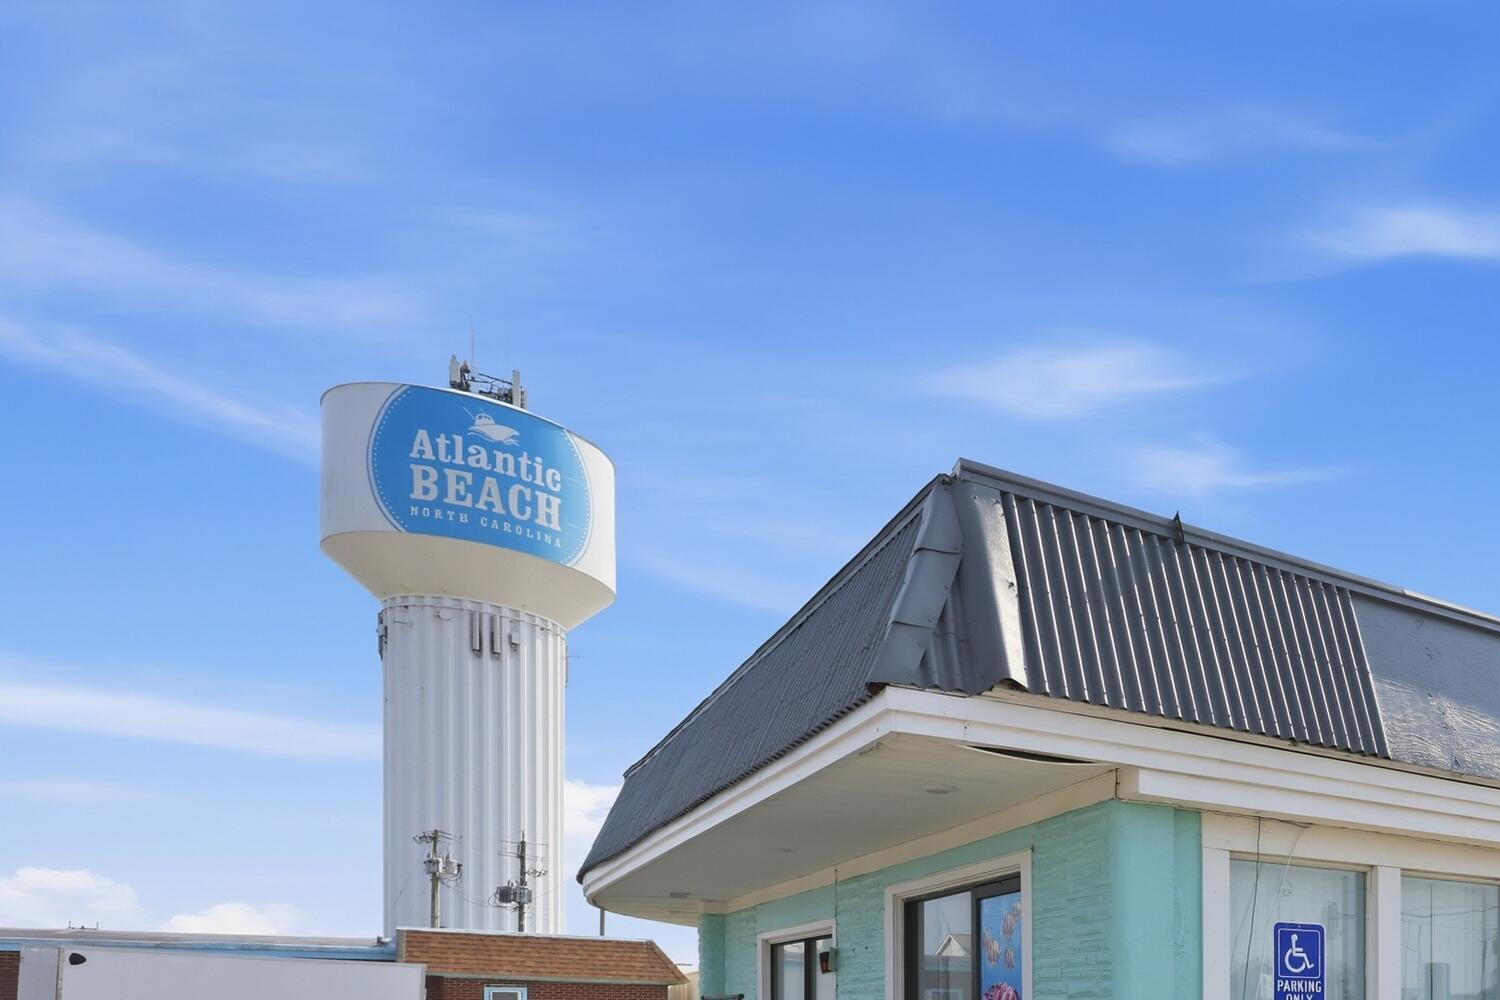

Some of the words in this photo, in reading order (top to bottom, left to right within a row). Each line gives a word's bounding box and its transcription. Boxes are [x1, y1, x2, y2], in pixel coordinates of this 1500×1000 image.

[409, 429, 561, 492] Atlantic
[409, 463, 562, 532] BEACH
[410, 506, 468, 524] NORTH
[480, 516, 561, 549] CAROLINA
[1277, 979, 1322, 993] PARKING
